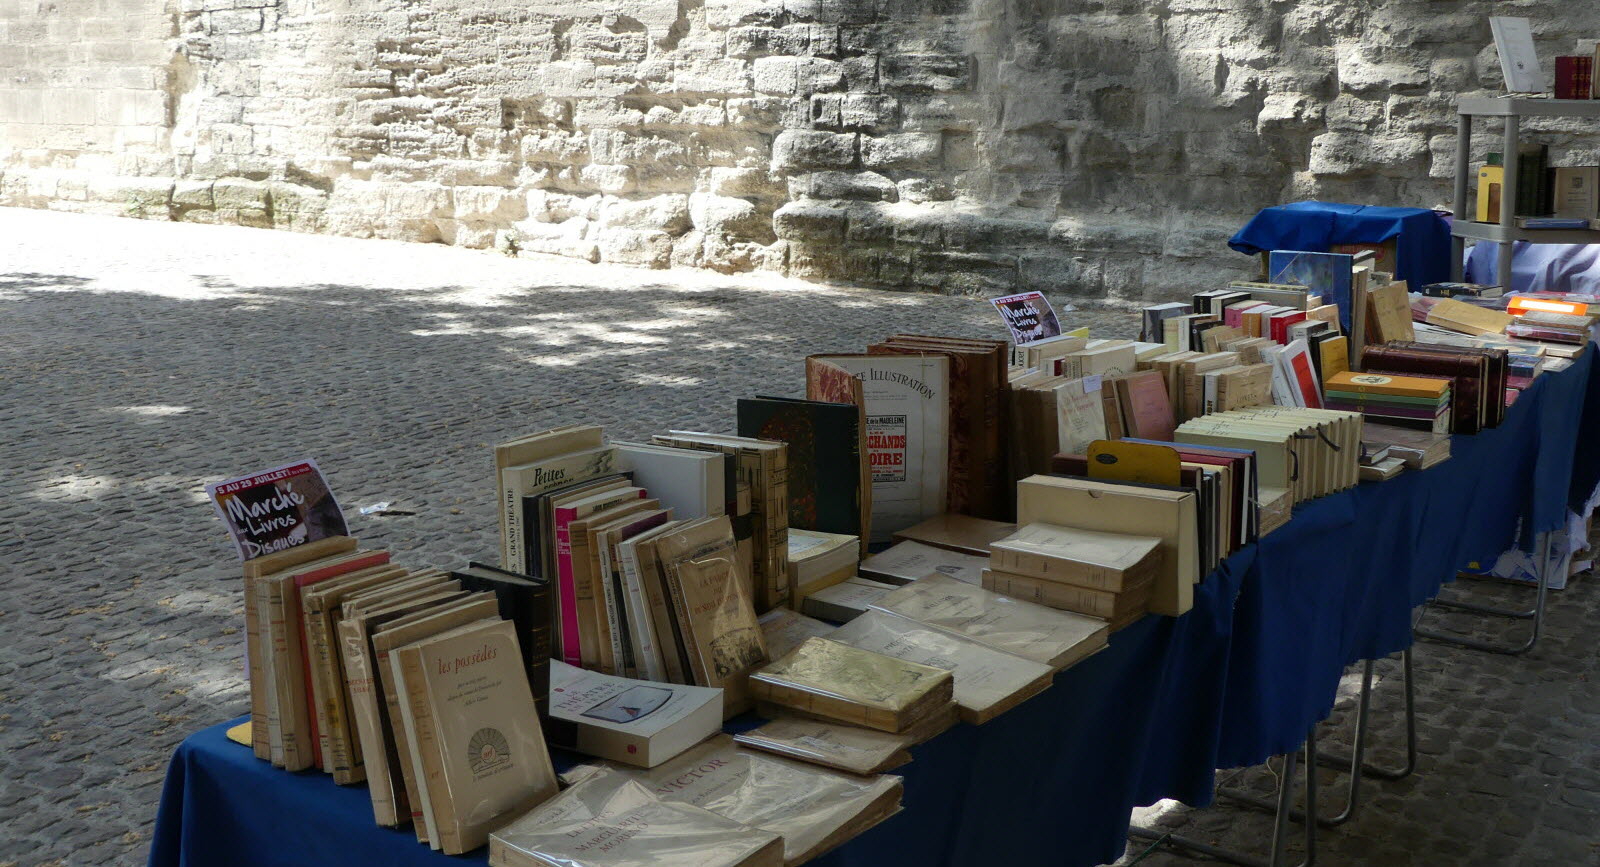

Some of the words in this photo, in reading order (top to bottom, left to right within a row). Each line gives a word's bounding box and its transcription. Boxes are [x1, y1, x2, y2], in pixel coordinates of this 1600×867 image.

[1000, 301, 1040, 318] Marché
[1012, 317, 1038, 327] Livres
[870, 452, 902, 466] OIRE
[226, 483, 240, 492] AU
[240, 479, 252, 488] 29
[533, 467, 566, 488] Petites
[224, 482, 304, 523] Marché
[245, 513, 297, 536] Livres
[241, 533, 305, 559] Disques
[509, 527, 517, 557] GRAND
[437, 658, 452, 675] les
[656, 759, 729, 793] VICTOR
